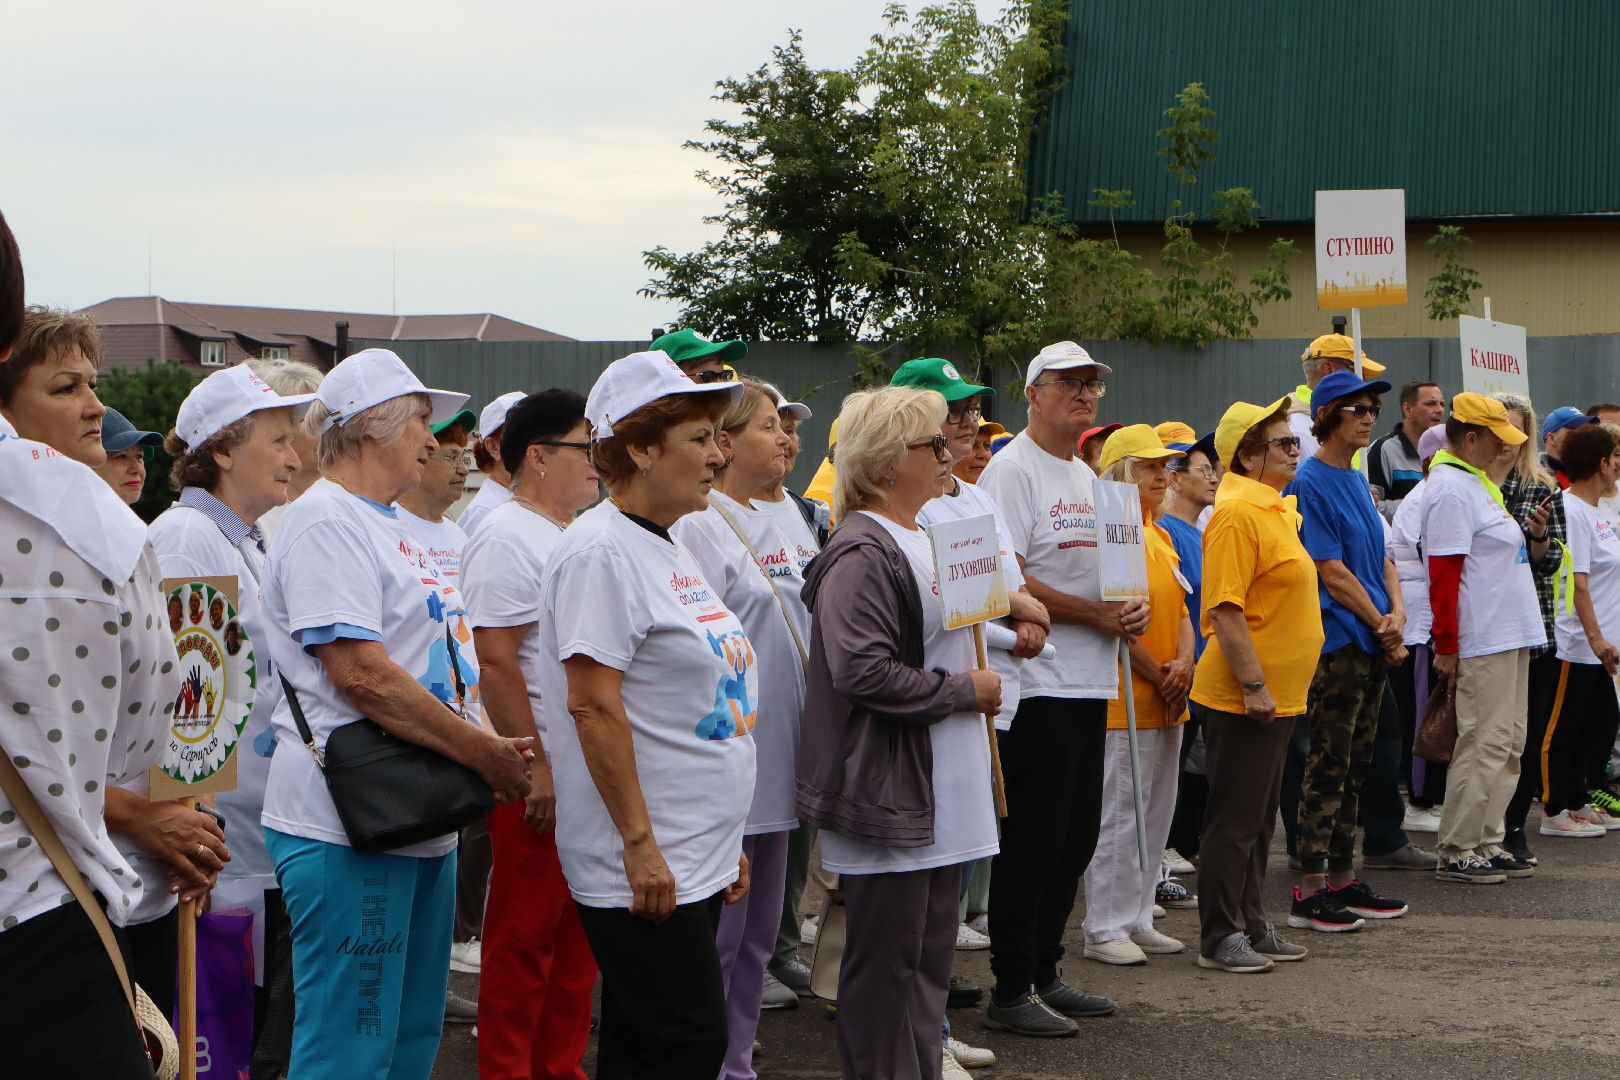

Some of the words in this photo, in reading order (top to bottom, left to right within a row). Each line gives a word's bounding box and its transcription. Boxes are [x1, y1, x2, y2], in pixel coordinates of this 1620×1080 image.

[1326, 236, 1394, 257] СТУПИНО
[1471, 347, 1520, 375] КАШИРА
[1105, 523, 1141, 545] ВИДНОЕ
[948, 555, 998, 582] ЛУХОВИЦЫ
[177, 634, 220, 671] ПОСЕДЫ
[335, 931, 404, 956] Natali
